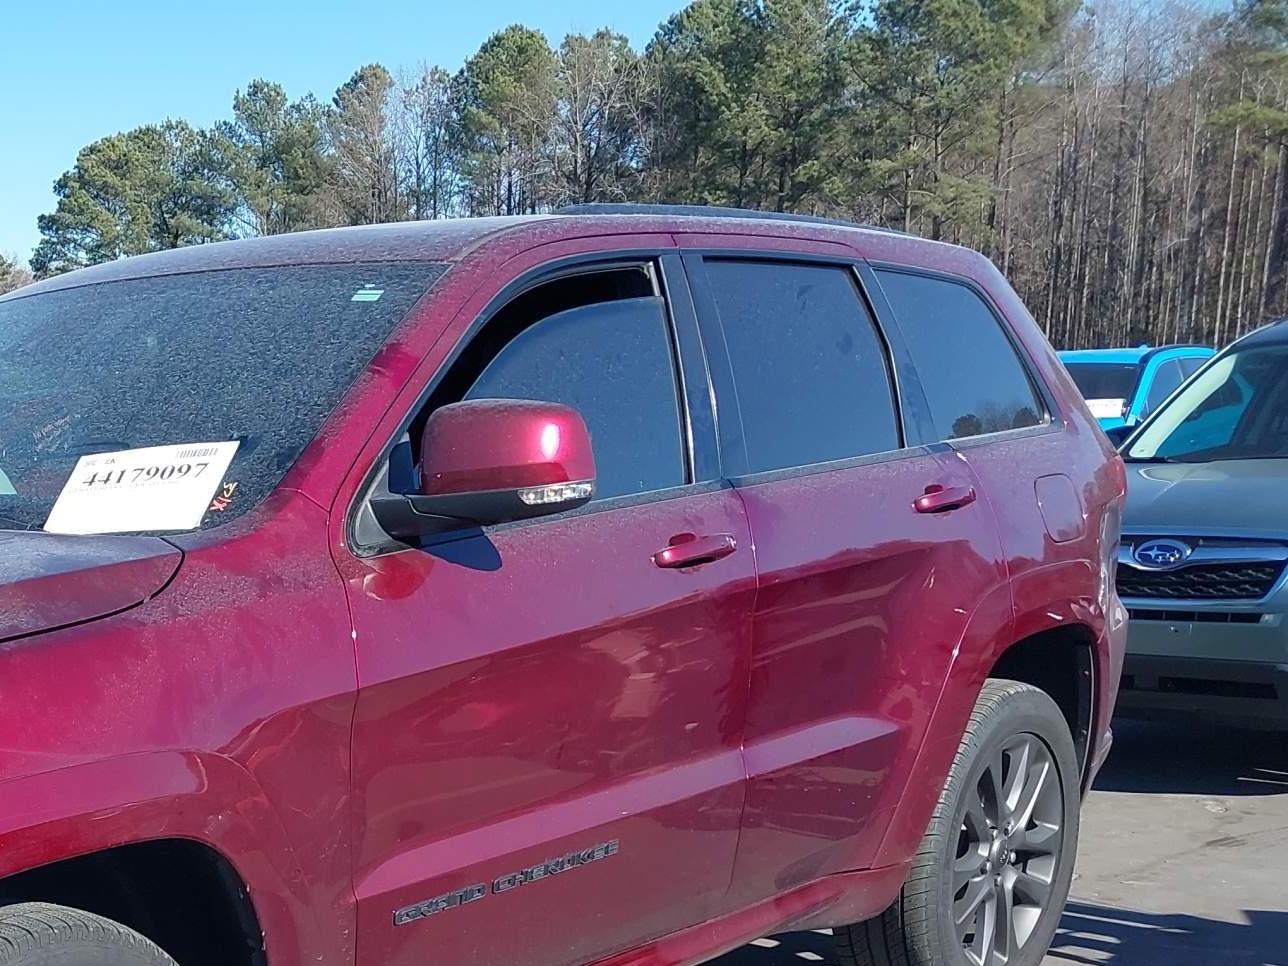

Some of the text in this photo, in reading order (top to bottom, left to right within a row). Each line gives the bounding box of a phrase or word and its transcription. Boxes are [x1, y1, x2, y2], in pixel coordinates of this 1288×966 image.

[82, 462, 210, 487] 44179097
[393, 839, 620, 927] GRAND CHEROKEE
